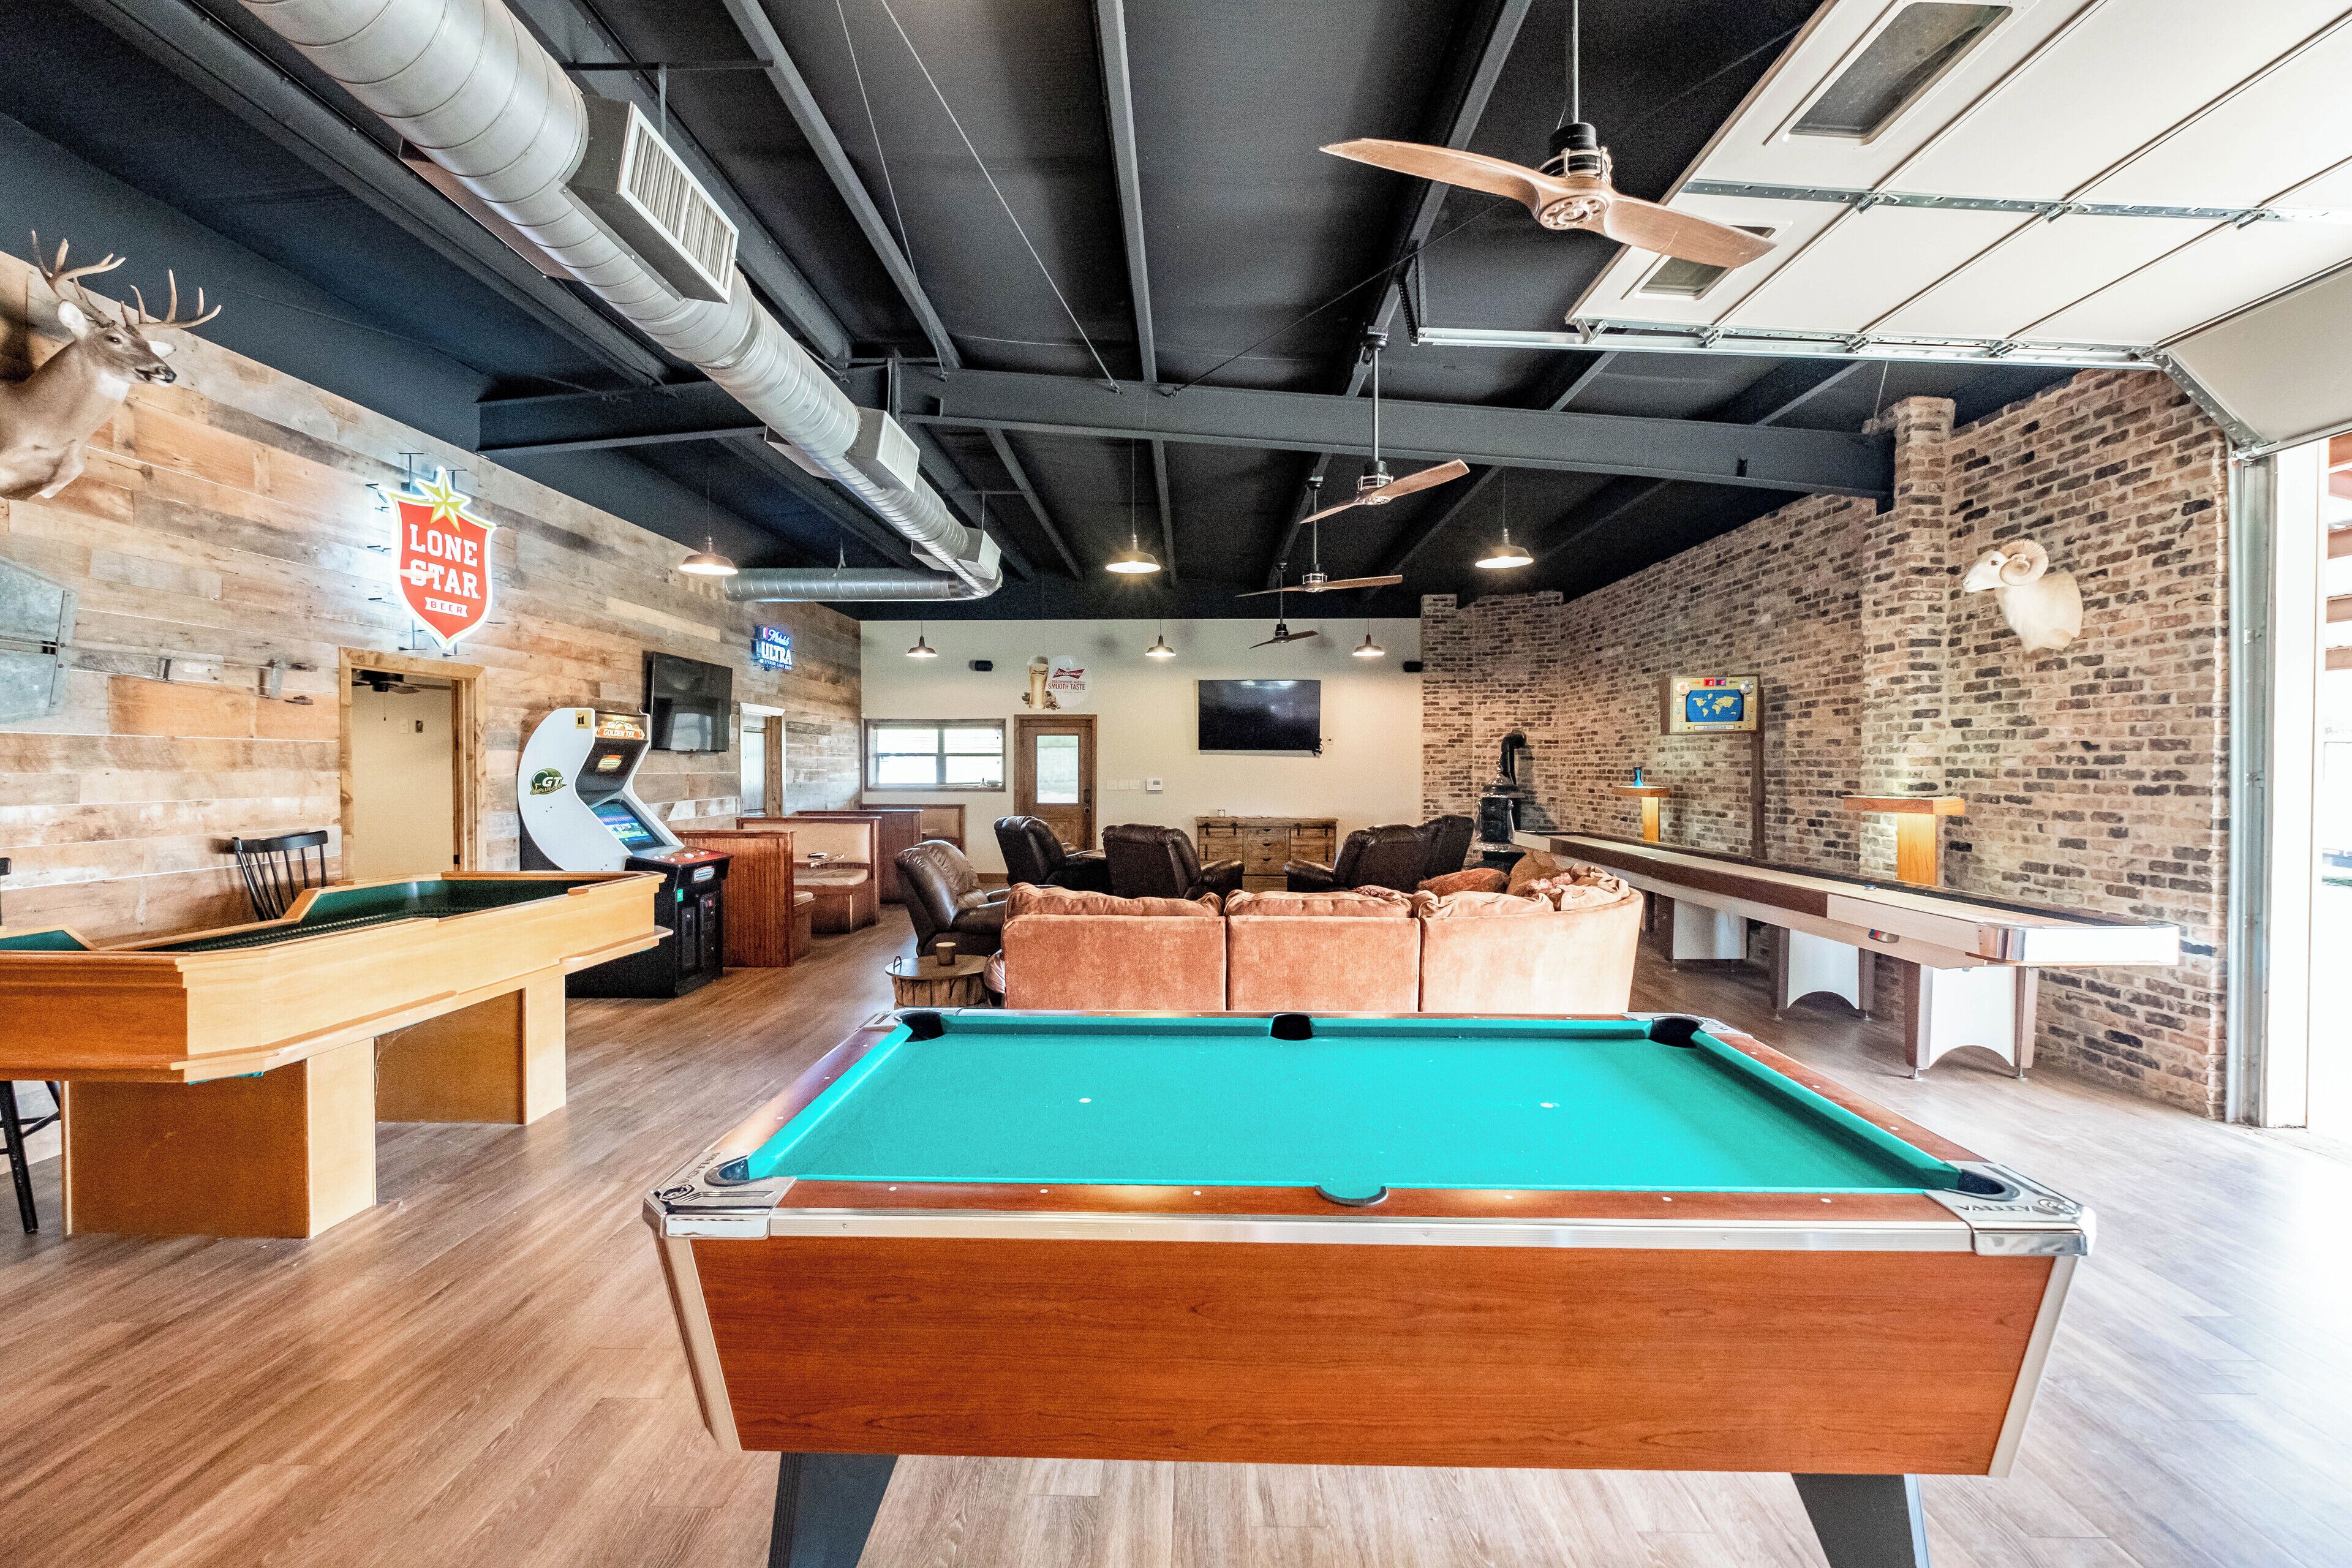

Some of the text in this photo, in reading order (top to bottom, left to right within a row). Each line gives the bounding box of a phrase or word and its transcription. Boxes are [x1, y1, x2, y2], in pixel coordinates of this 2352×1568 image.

[409, 523, 478, 567] LONE
[410, 558, 481, 600] STAR
[430, 600, 464, 614] BEER
[761, 641, 793, 665] ULTRA
[542, 777, 562, 786] GT
